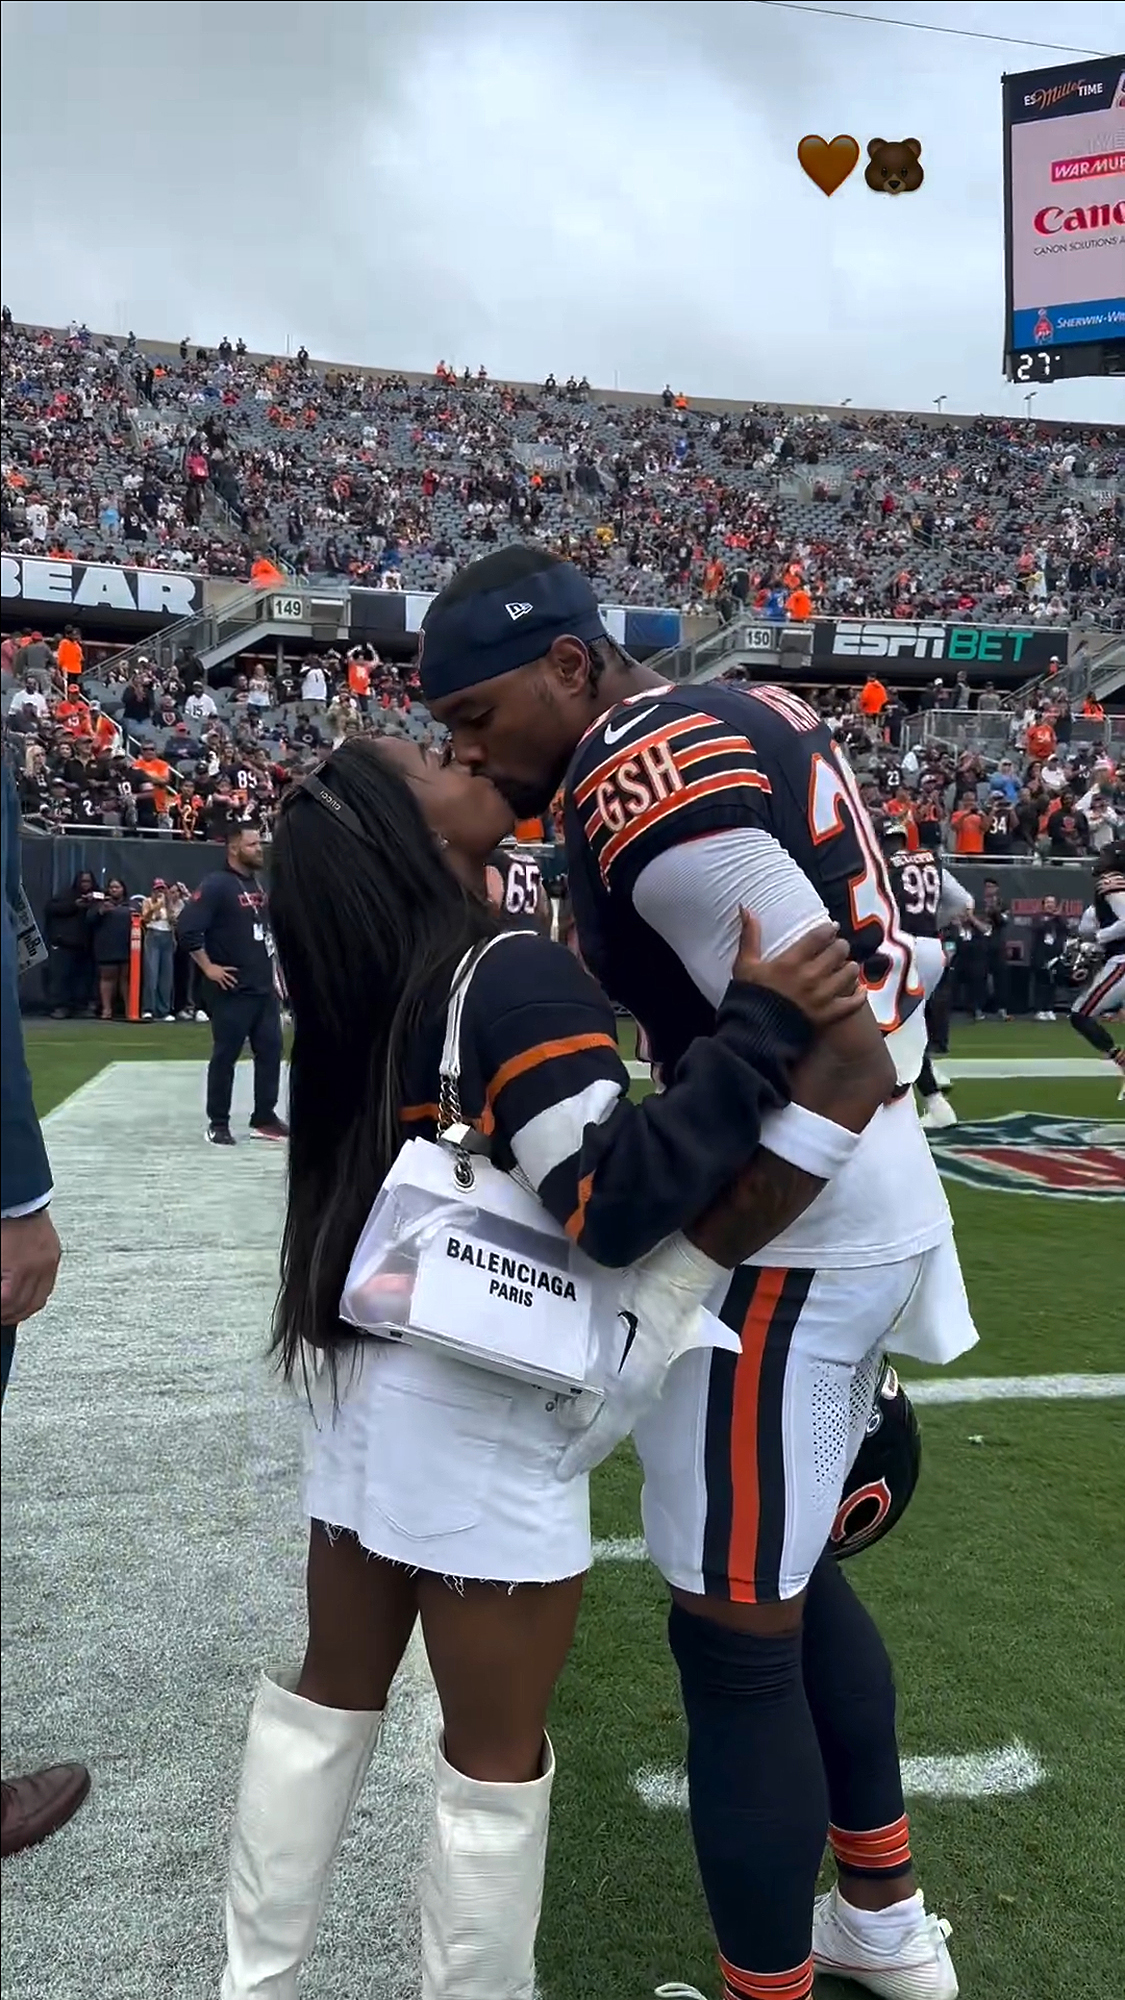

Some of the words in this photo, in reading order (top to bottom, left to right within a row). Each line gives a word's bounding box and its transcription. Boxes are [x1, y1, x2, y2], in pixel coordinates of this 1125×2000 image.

[1079, 83, 1103, 96] TIME
[1034, 244, 1068, 256] CANON
[1069, 236, 1117, 251] SOLUTIONS
[275, 600, 301, 616] 149
[748, 631, 770, 645] 150
[833, 622, 946, 659] ESPN
[949, 628, 1034, 662] BET
[320, 790, 342, 811] GUCCI
[596, 741, 685, 832] GSH
[506, 863, 540, 914] 65
[902, 864, 940, 914] 99
[446, 1237, 577, 1302] BALENCIAGA
[489, 1279, 533, 1307] PARIS
